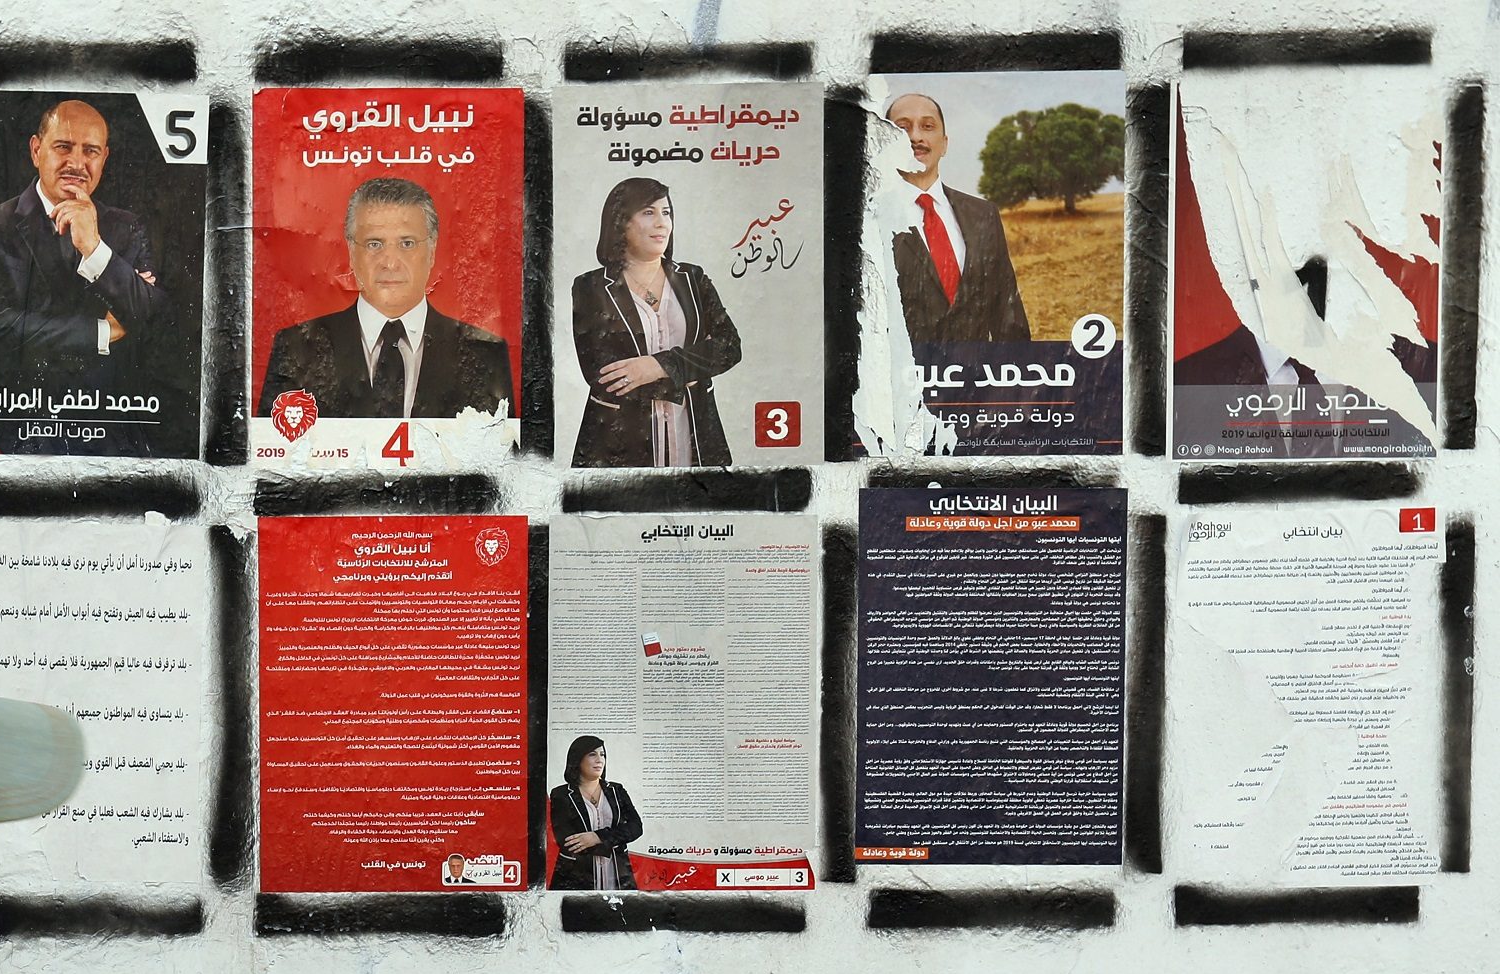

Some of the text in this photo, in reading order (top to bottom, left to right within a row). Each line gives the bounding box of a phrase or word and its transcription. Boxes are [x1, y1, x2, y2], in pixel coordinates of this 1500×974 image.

[302, 102, 474, 141] نبيل القروي
[576, 103, 800, 131] ديمقراطية مسؤولة
[166, 110, 197, 159] 5
[302, 145, 475, 173] في قلب تونس
[607, 140, 780, 168] حريات مضمونة
[1082, 319, 1106, 352] 2
[974, 362, 1076, 389] محمد
[47, 389, 100, 418] لطفي
[105, 393, 160, 414] محمد
[1225, 388, 1306, 418] الرحوي
[765, 408, 790, 441] 3
[975, 408, 1024, 428] قوية
[1028, 409, 1075, 428] دولة
[18, 422, 107, 444] صوت العقل
[1221, 429, 1245, 439] 2019
[1278, 428, 1312, 439] السابقة
[381, 421, 415, 467] 4
[1217, 445, 1273, 455] Mongi Rahoui
[1343, 442, 1434, 455] www.mongirahoui.tn
[256, 447, 286, 460] 2019
[336, 447, 349, 459] 15
[929, 494, 1058, 515] البيان الانتخابي
[909, 517, 942, 530] وعادلة
[942, 518, 967, 530] قوية
[968, 517, 992, 530] دولة
[1014, 519, 1029, 530] من
[1031, 520, 1048, 530] عبو
[1412, 513, 1425, 531] 1
[351, 530, 433, 540] بسم الله الرحمن الرحيم
[640, 524, 734, 544] البيان الإنتخابي
[1282, 526, 1343, 542] بيان انتخابي
[354, 541, 432, 558] أنا نبيل القروي
[8, 556, 20, 570] بين
[21, 554, 41, 567] شامخة
[42, 555, 59, 571] بلادنا
[60, 555, 72, 571] فيه
[73, 557, 86, 571] نرى
[87, 560, 99, 573] يوم
[100, 553, 115, 575] يأتي
[116, 553, 125, 571] أن
[125, 553, 138, 571] أمل
[139, 557, 162, 572] صدورنا
[163, 557, 178, 576] وفي
[179, 558, 193, 573] نحيا
[371, 559, 414, 569] للانتخابات
[414, 557, 448, 569] المترشح
[332, 572, 372, 584] وبرنامجي
[372, 572, 401, 584] برؤيتي
[400, 572, 427, 582] إليكم
[20, 605, 38, 621] شبابه
[38, 601, 52, 622] أمام
[53, 602, 70, 619] الأمل
[71, 602, 90, 621] أبواب
[91, 606, 102, 622] فيه
[103, 607, 123, 624] وتفتح
[124, 607, 144, 623] العيش
[145, 607, 156, 623] فيه
[157, 607, 177, 623] يطيب
[76, 709, 102, 721] جميعهم
[103, 706, 136, 722] المواطنون
[137, 706, 147, 722] فيه
[149, 707, 172, 723] يتساوى
[174, 708, 184, 723] بلد
[94, 756, 113, 774] القوي
[114, 756, 126, 772] قبل
[127, 756, 154, 772] الضعيف
[155, 761, 174, 775] يحمي
[158, 831, 189, 847] والاستفتاء
[647, 846, 803, 857] ديمقراطية مسؤولة و حريات مضمونة
[862, 847, 926, 859] دولة قوية وعادلة
[360, 859, 427, 872] تونس في القلب
[504, 865, 517, 881] 4
[473, 870, 503, 878] نبيل القروي
[720, 872, 731, 883] X
[765, 875, 780, 883] عبير
[794, 871, 805, 883] 3
